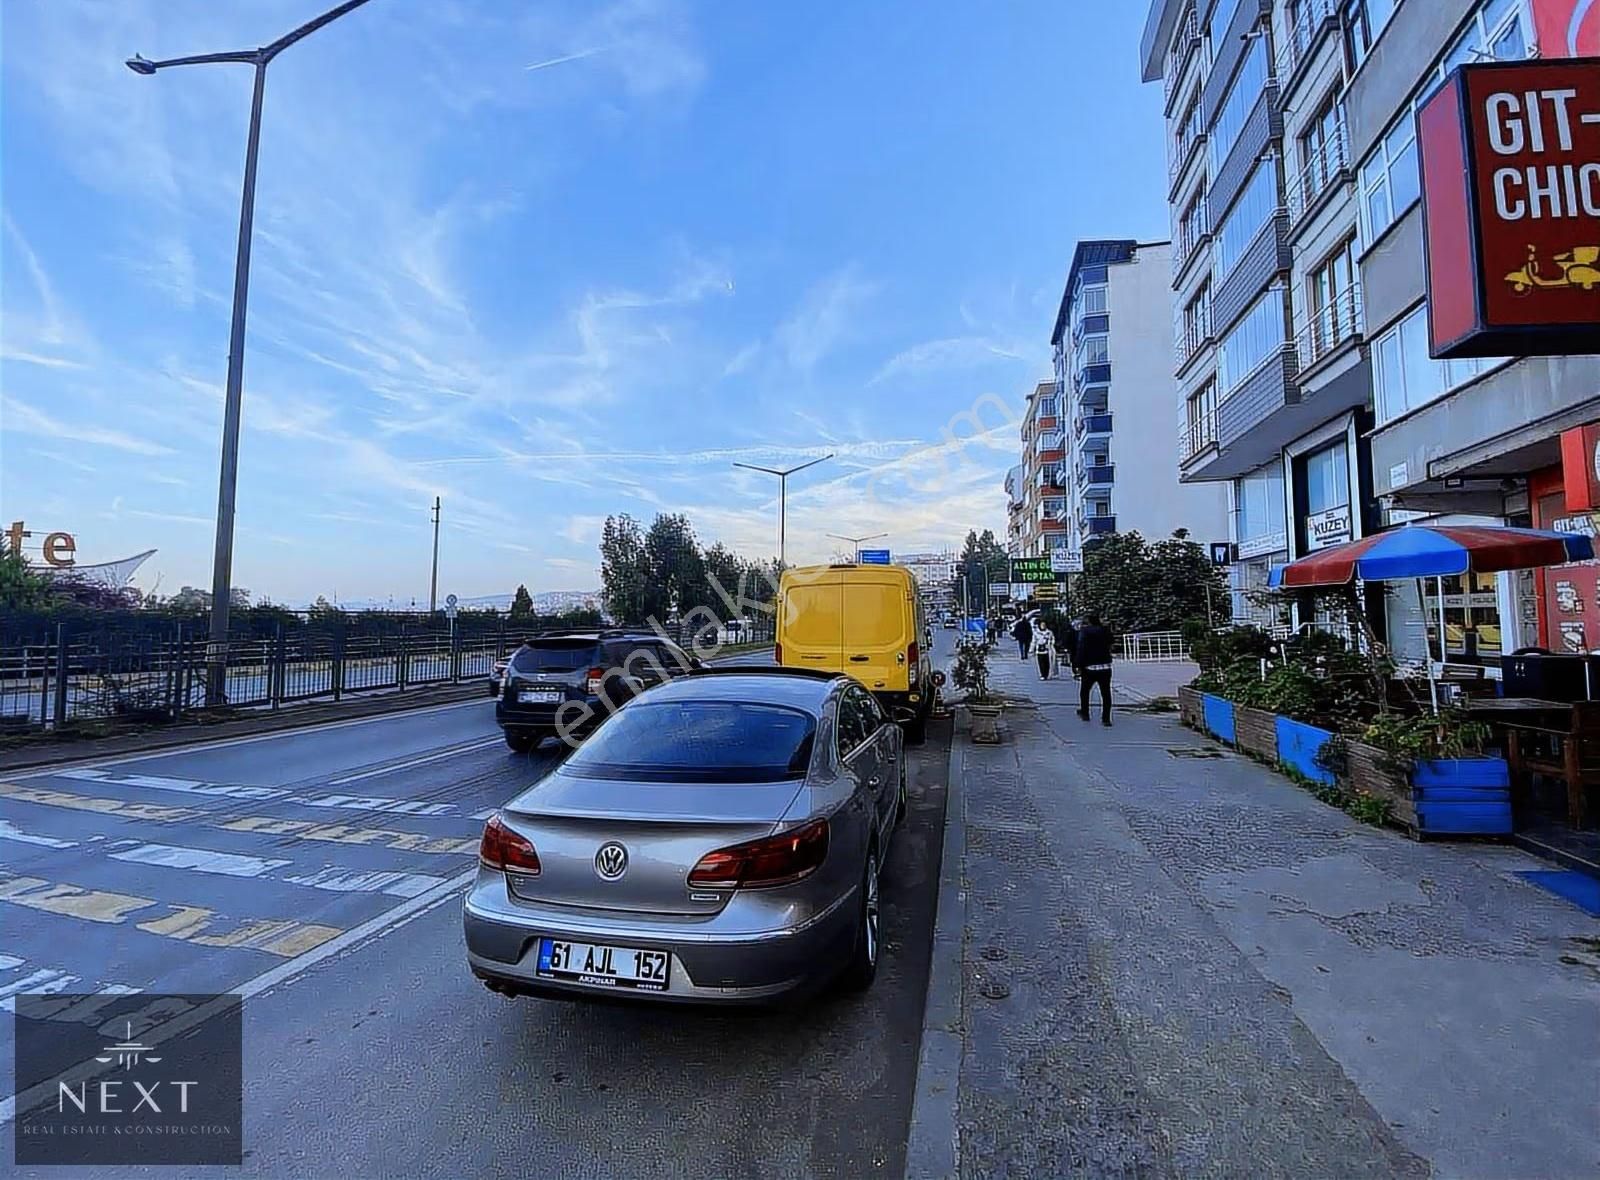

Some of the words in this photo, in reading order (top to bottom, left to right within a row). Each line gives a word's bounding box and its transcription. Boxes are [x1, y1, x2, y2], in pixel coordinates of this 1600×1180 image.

[1485, 89, 1600, 155] GIT-
[1313, 516, 1348, 536] KUZEY
[1014, 561, 1038, 570] ALTIN
[1021, 572, 1055, 581] TOPTAN
[551, 942, 571, 969] 61
[584, 946, 617, 975] AJL
[634, 951, 666, 980] 152
